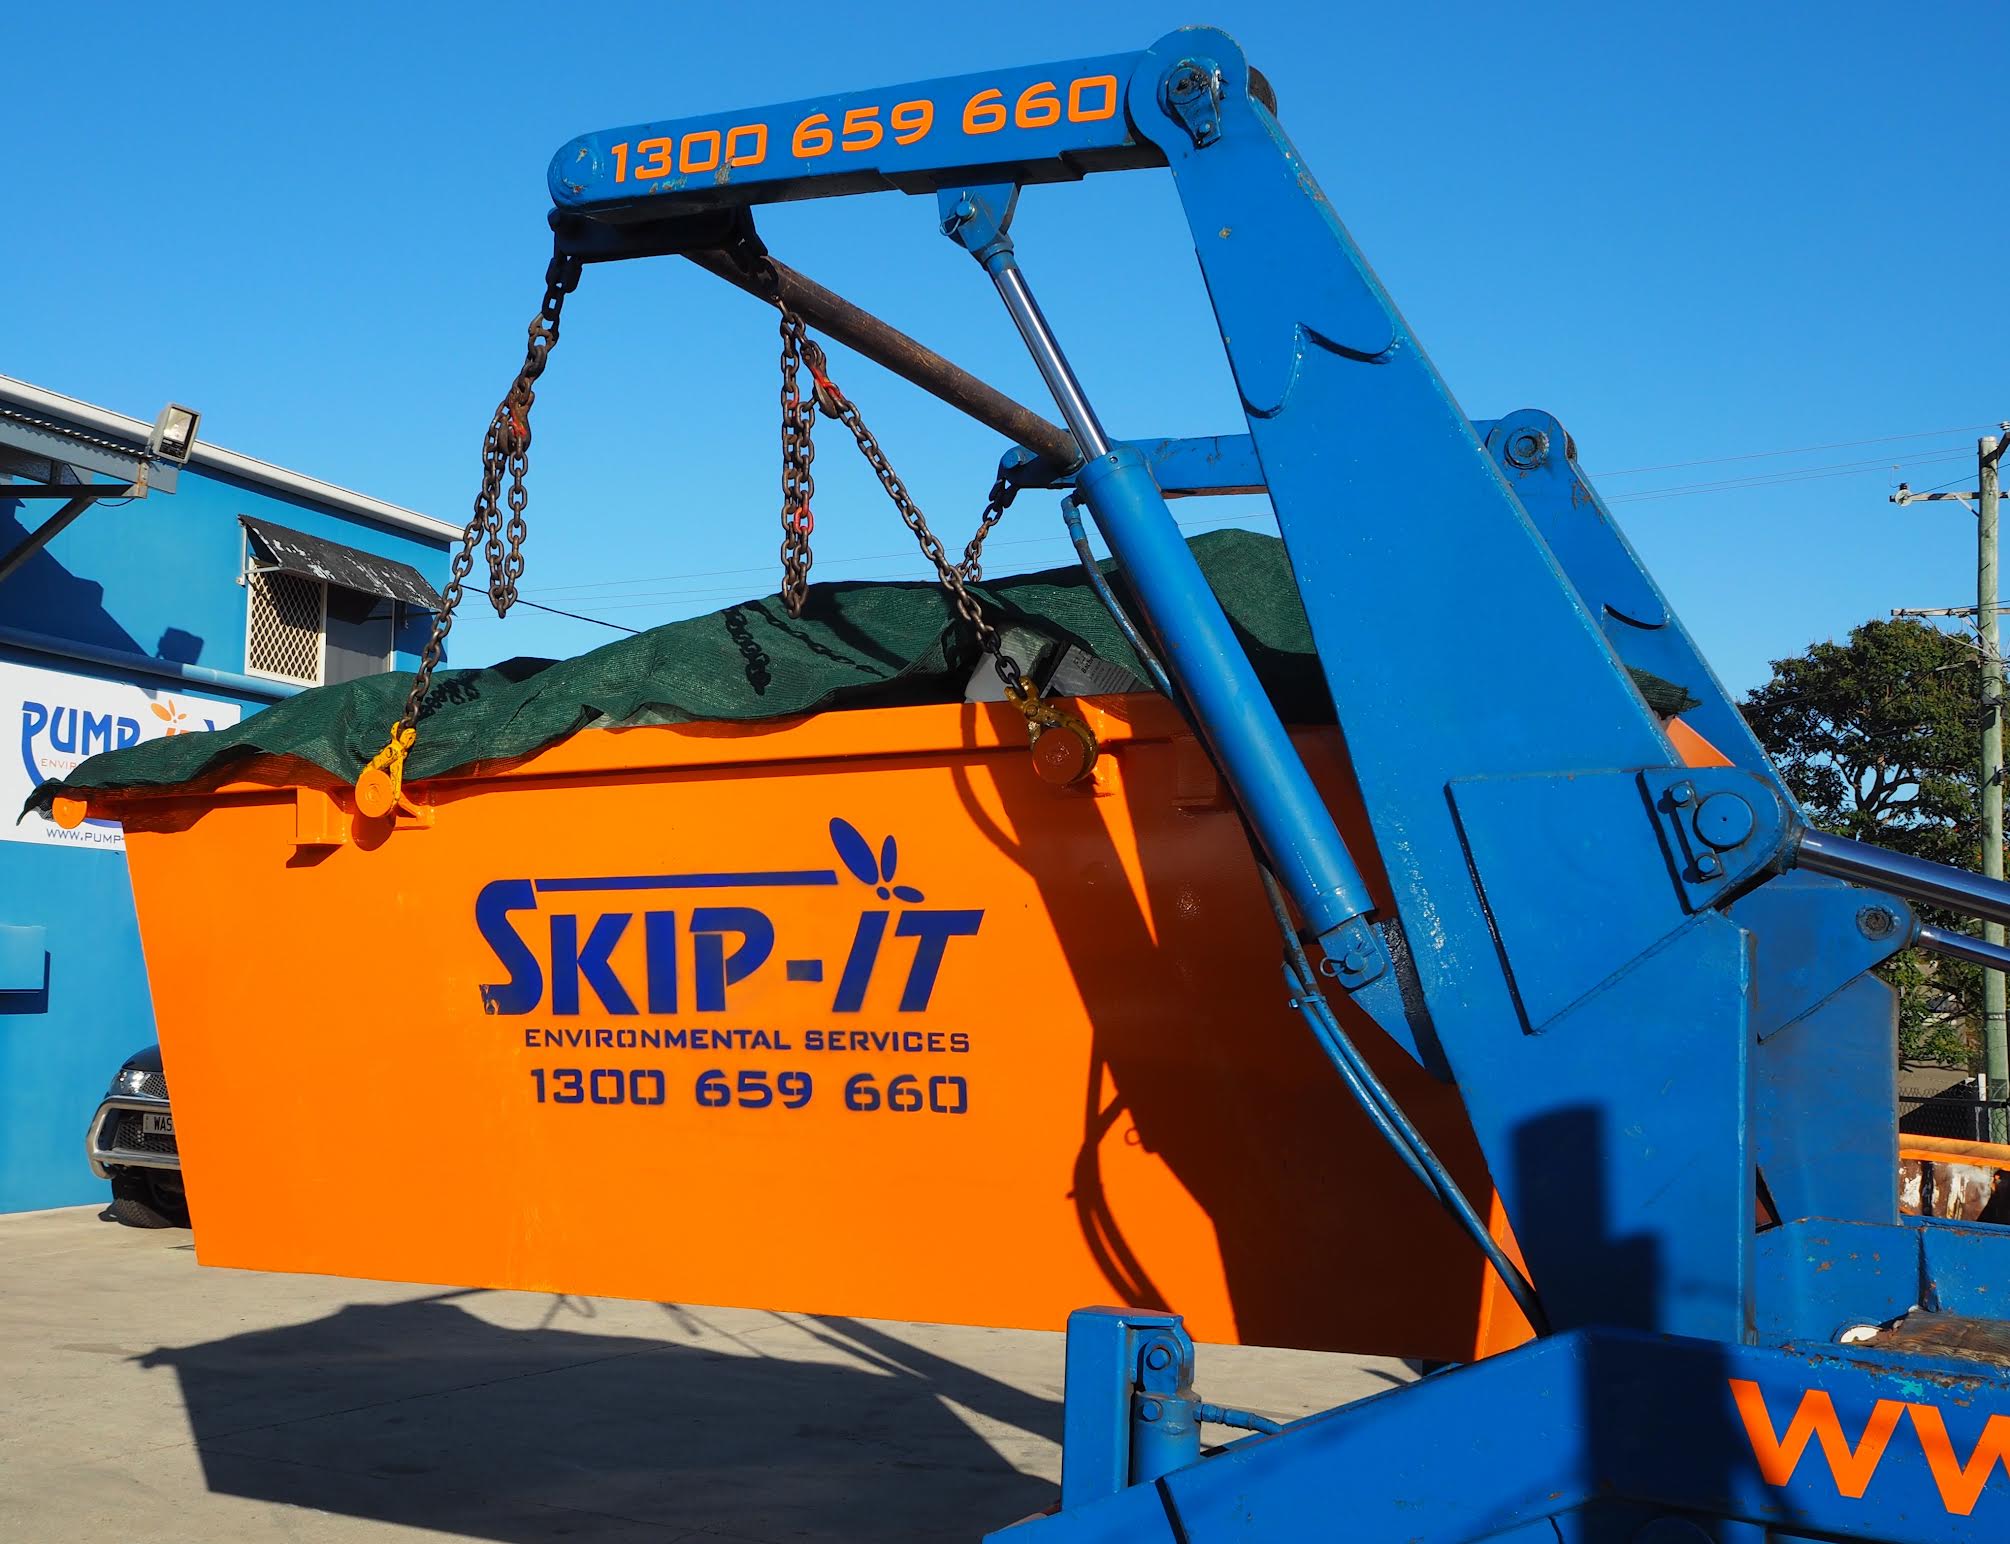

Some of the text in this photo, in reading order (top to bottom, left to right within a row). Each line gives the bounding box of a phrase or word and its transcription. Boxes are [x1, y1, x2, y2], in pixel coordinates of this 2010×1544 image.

[610, 74, 1118, 183] 1300 659 660
[22, 700, 187, 758] PUMP
[475, 872, 985, 1015] SKIP-IT
[525, 1028, 970, 1053] ENVIRONMENTAL SERVICES
[531, 1068, 968, 1115] 1300 659 660
